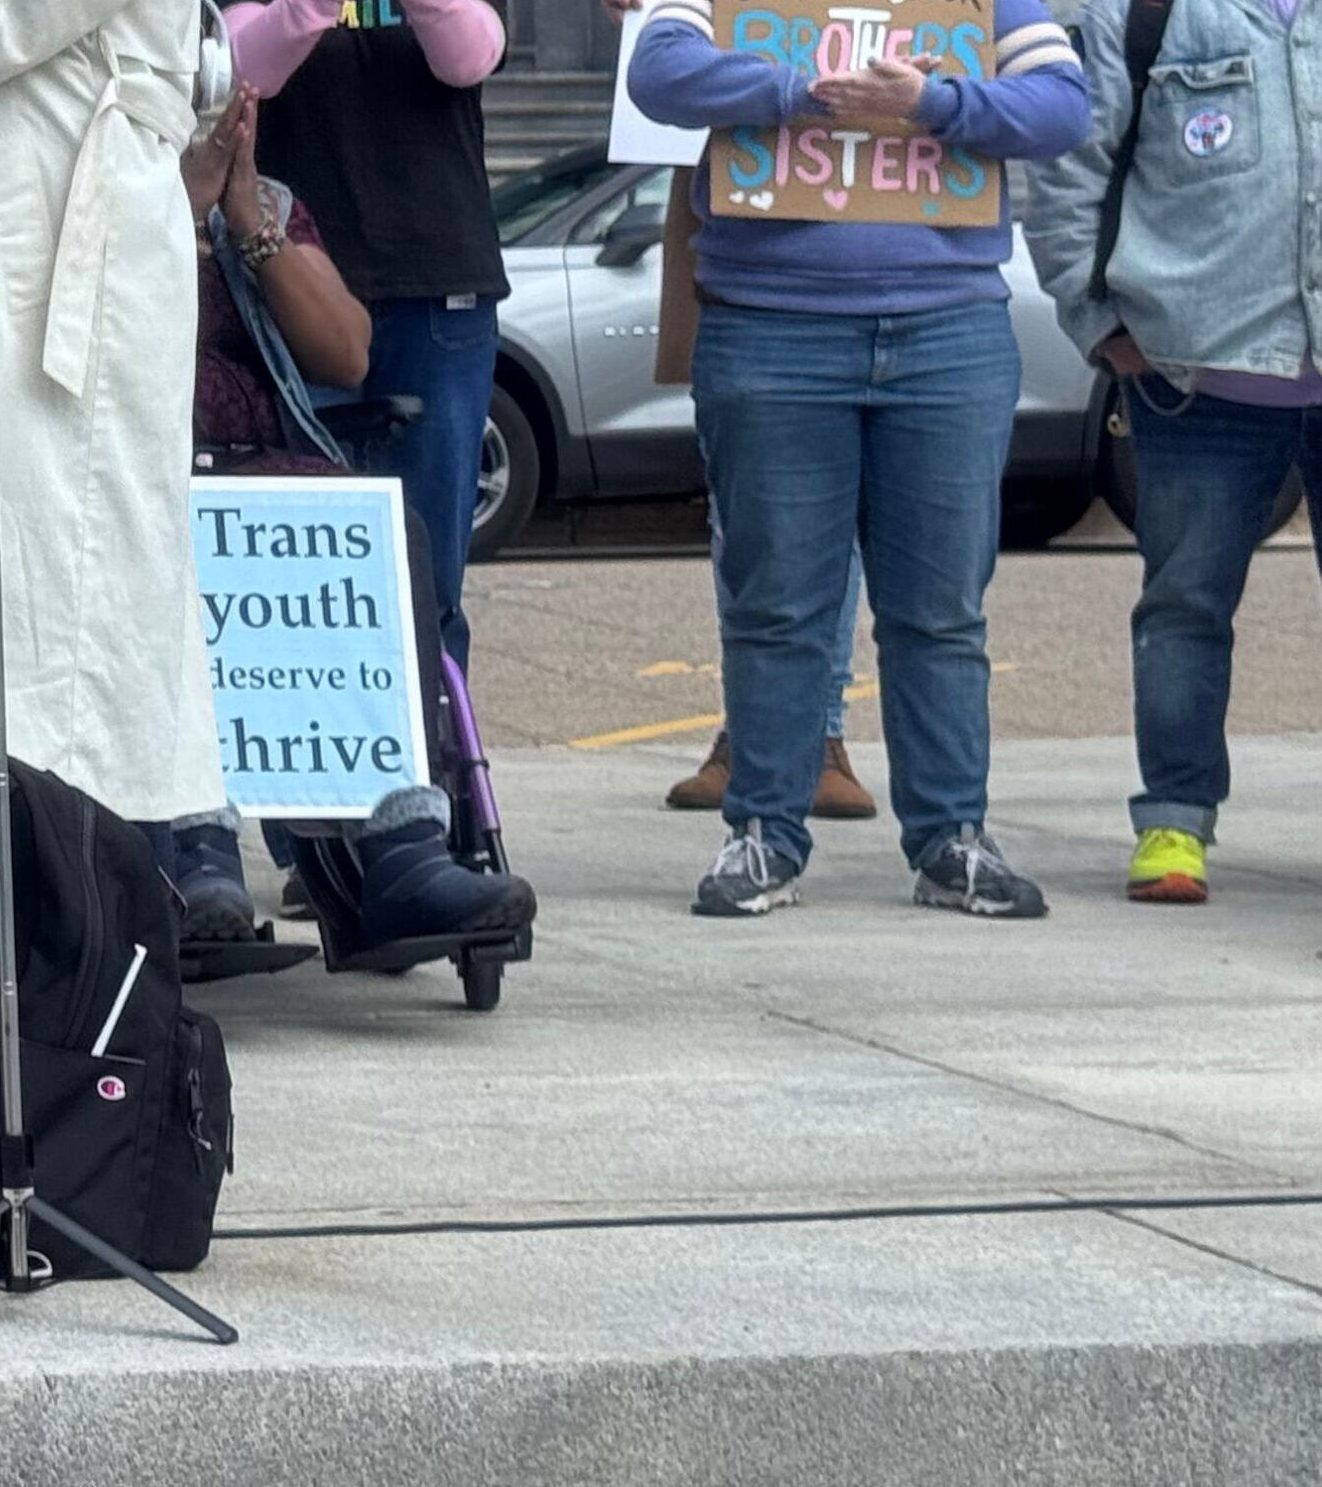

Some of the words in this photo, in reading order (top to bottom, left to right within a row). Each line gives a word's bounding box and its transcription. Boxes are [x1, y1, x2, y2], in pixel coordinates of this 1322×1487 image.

[729, 127, 986, 199] SISTERS
[197, 507, 372, 559] Trans
[199, 577, 382, 645] youth
[359, 661, 392, 691] to
